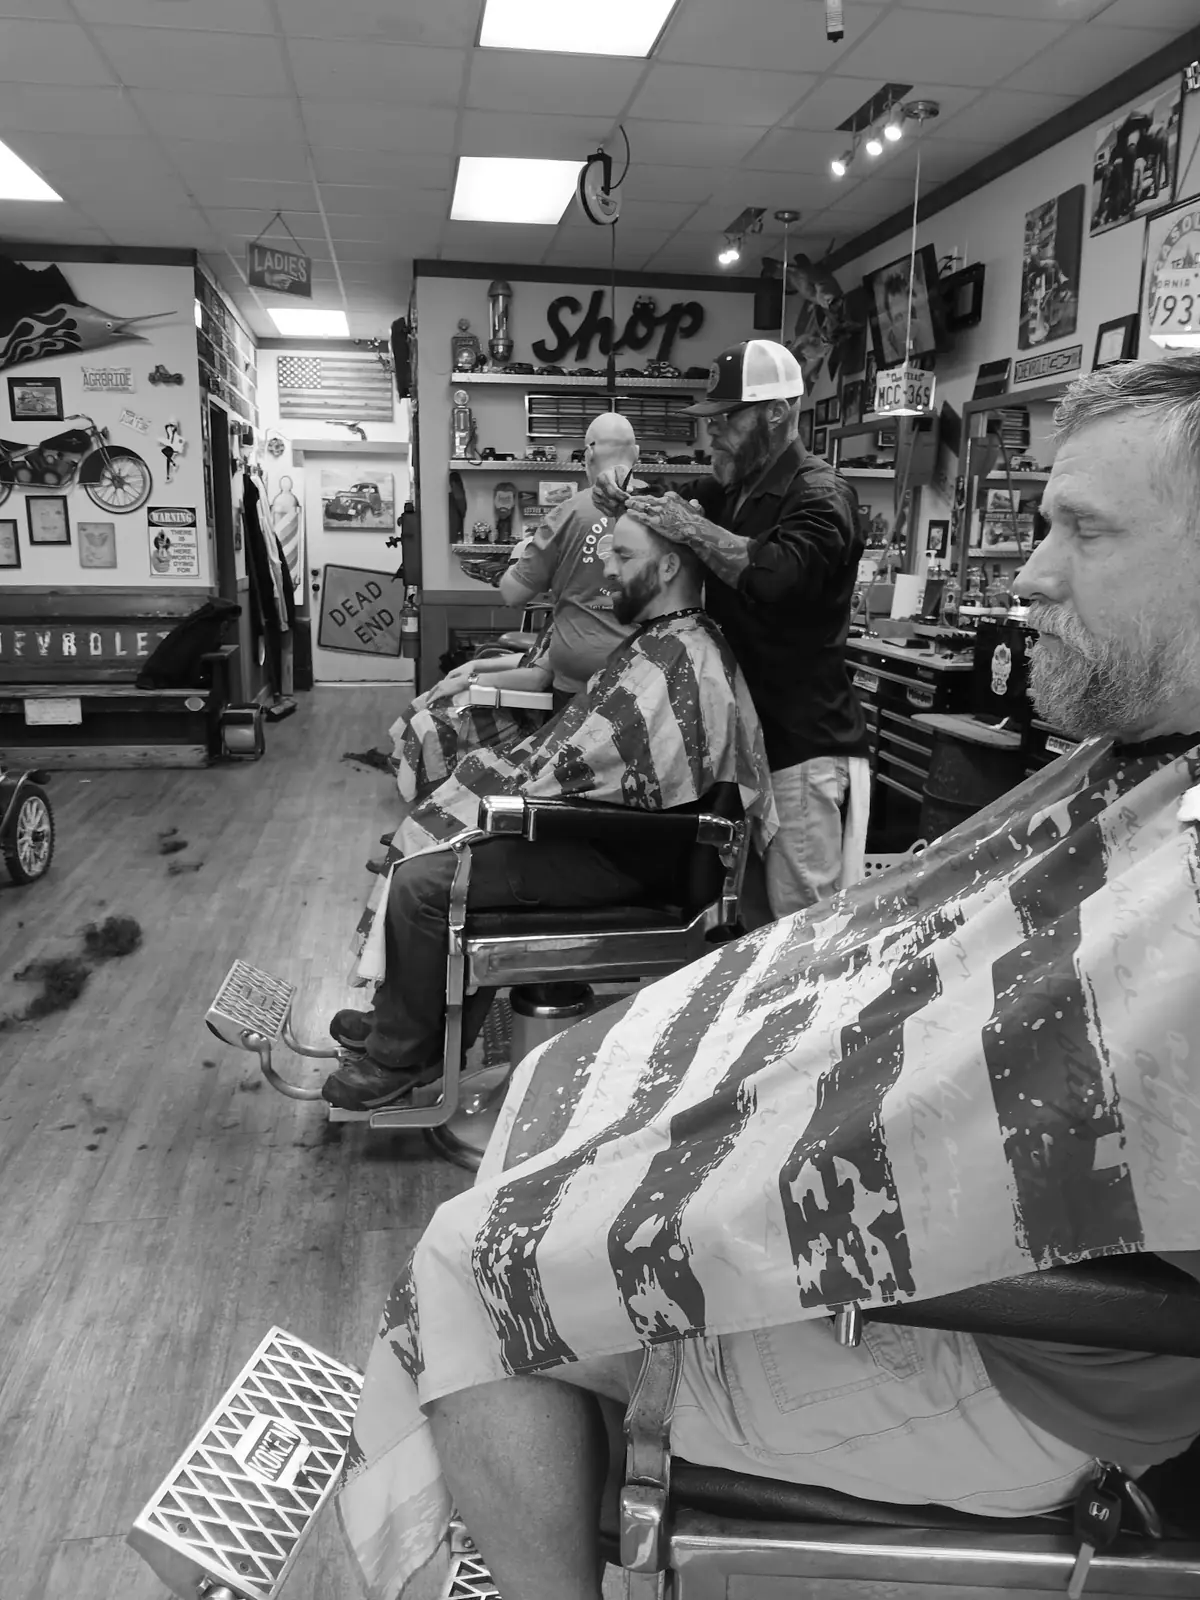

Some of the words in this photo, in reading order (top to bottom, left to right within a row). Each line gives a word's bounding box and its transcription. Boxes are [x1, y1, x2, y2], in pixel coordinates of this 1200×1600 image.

[255, 249, 306, 282] LADIES
[532, 290, 704, 363] Shop
[151, 512, 194, 523] WARNING
[583, 517, 608, 563] SCOOP
[329, 581, 382, 627] DEAD
[0, 631, 171, 656] EVROLE
[354, 609, 394, 644] END
[247, 1422, 300, 1480] KOKEN
